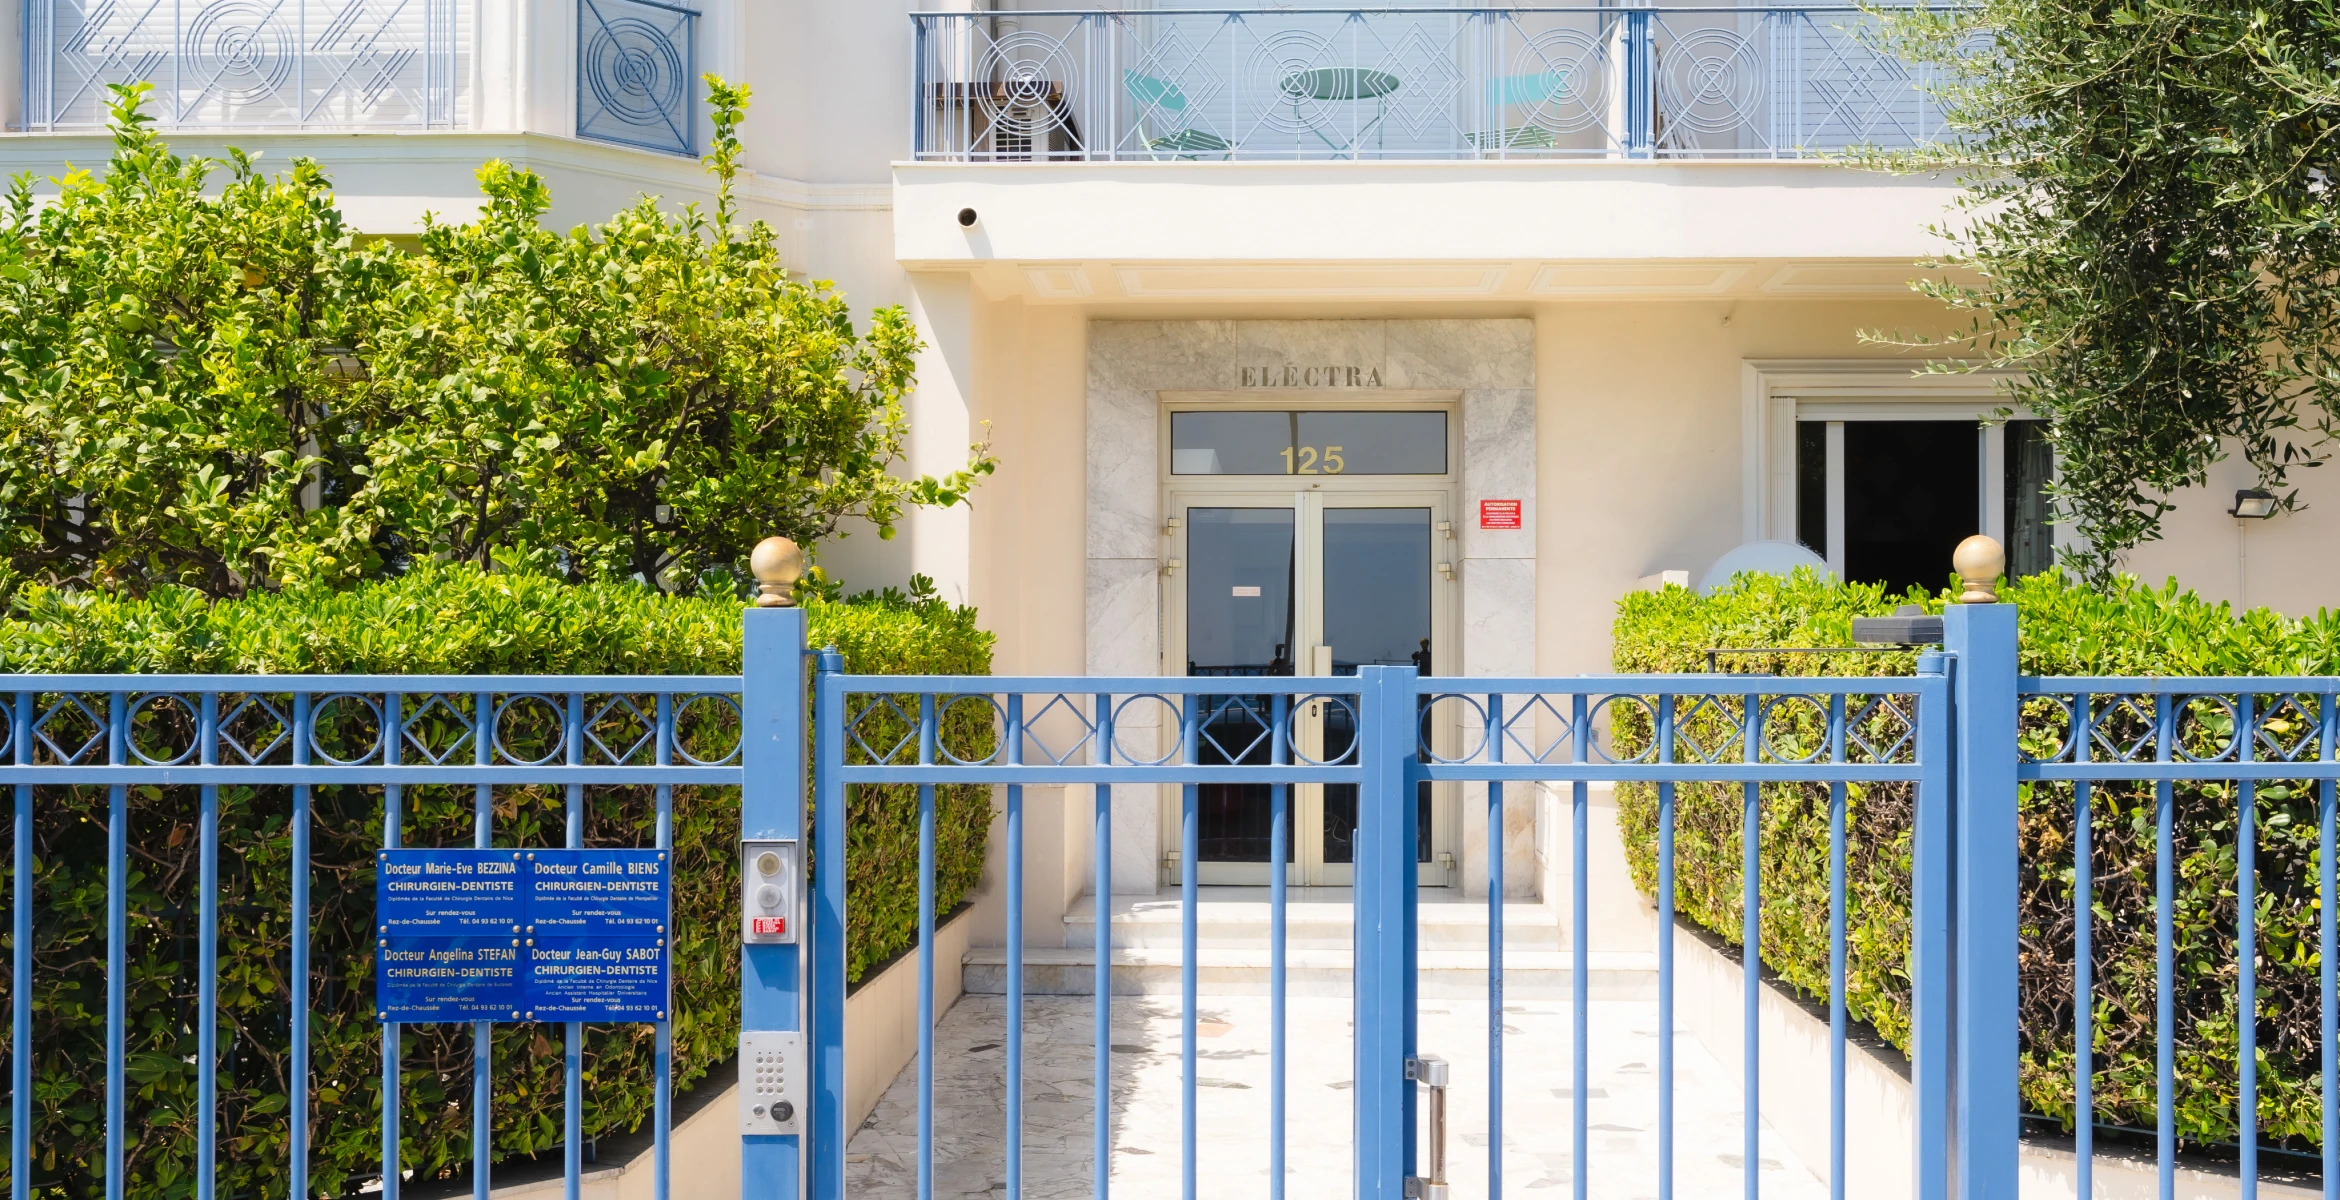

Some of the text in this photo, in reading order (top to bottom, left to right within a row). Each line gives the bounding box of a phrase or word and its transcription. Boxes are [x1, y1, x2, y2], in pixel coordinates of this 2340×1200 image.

[1280, 446, 1344, 475] 125
[385, 862, 516, 874] Docteur Marie-Eve BEZZINA
[534, 862, 659, 874] Docteur Camille BIENS
[388, 882, 514, 891] CHIRURGIEN-DENTISTE
[535, 882, 658, 891] CHIRURGIEN-DENTISTE
[384, 948, 516, 964] Docteur Angelina STEFAN
[532, 948, 660, 963] Docteur Jean-Guy SABOT
[388, 968, 513, 977] CHIRURGIEN-DENTISTE
[534, 966, 658, 975] CHIRURGIEN-DENTISTE
